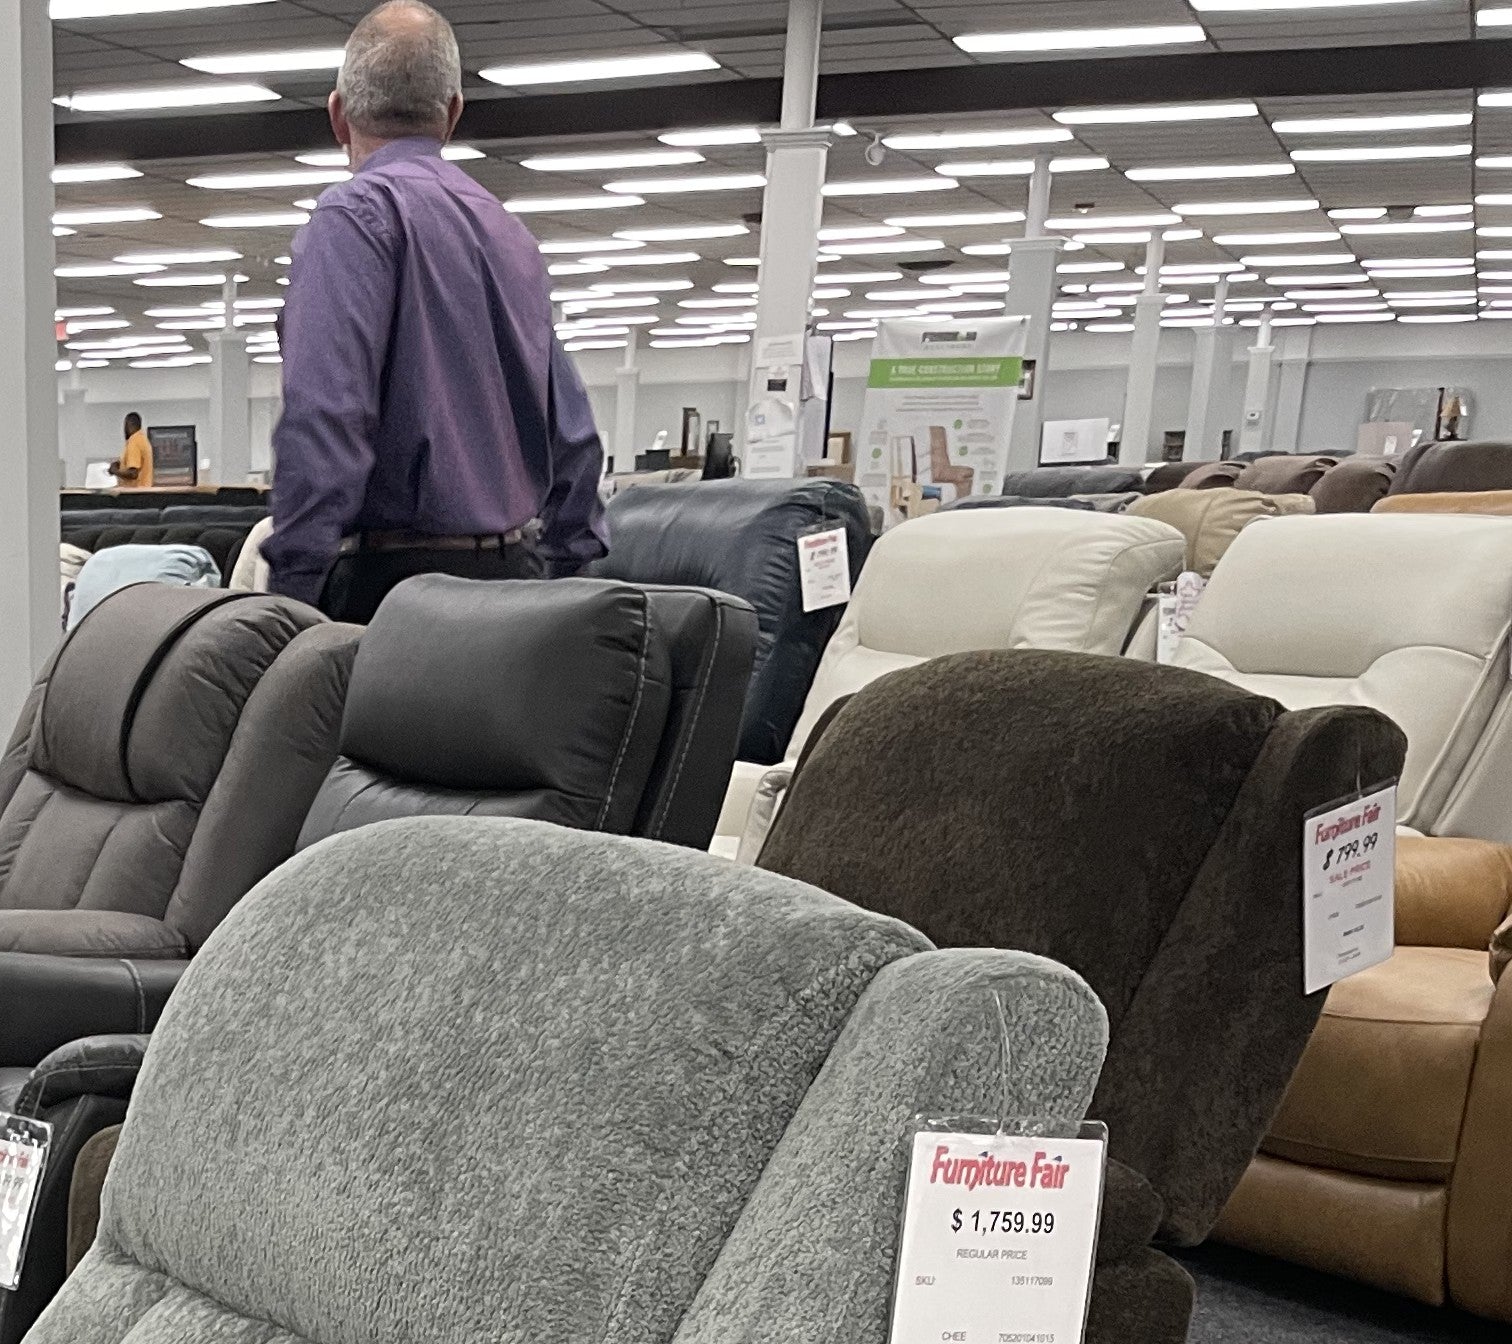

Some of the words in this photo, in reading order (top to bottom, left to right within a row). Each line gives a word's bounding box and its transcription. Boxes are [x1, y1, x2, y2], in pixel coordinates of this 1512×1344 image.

[1336, 832, 1378, 865] 799.99
[930, 1145, 1027, 1192] Furniture
[1029, 1151, 1071, 1190] Fair
[971, 1208, 1056, 1237] 1,759.99
[956, 1248, 999, 1260] REGULAR
[1000, 1249, 1028, 1261] PRICE
